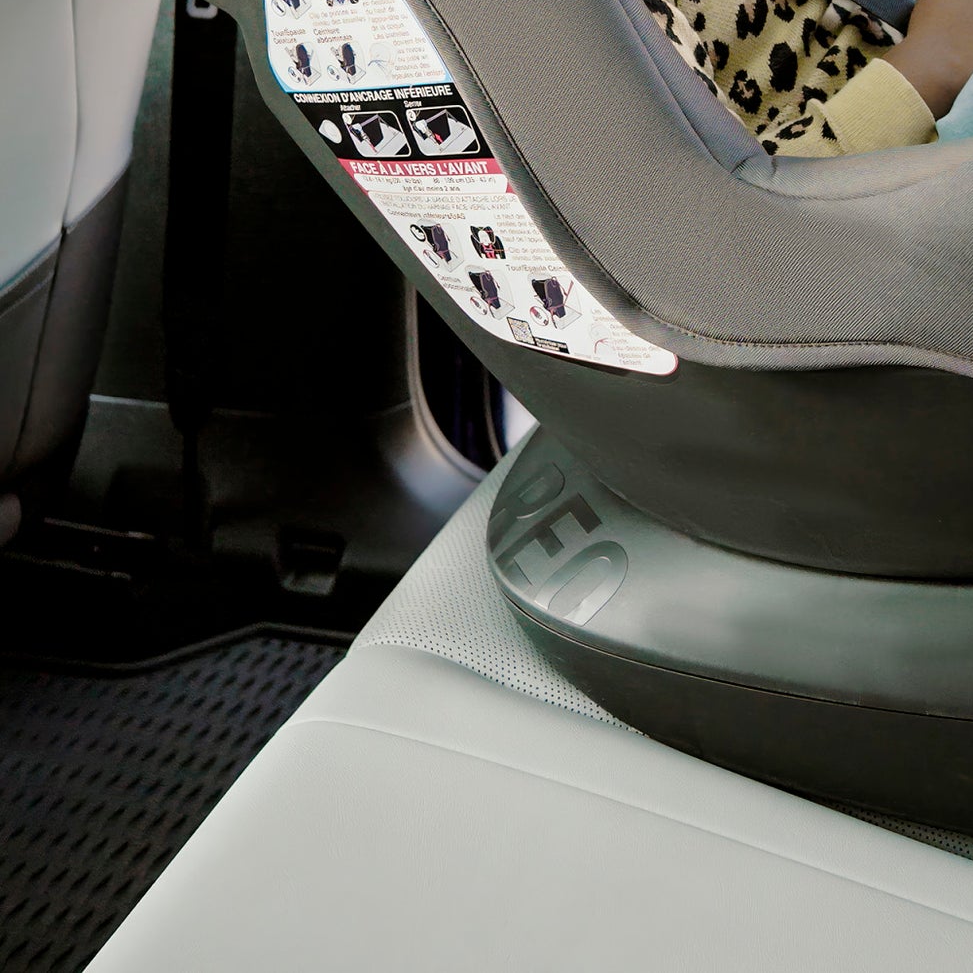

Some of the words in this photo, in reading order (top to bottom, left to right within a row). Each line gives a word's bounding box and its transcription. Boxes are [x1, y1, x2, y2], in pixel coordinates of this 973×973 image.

[294, 92, 342, 104] CONNEXION
[340, 90, 395, 103] D'ANCRAGE
[394, 84, 453, 100] INFÉRIEURE
[350, 161, 378, 175] FACE
[376, 160, 388, 176] À
[389, 163, 405, 176] LA
[404, 163, 437, 177] VERS
[437, 160, 489, 176] L'AVANT
